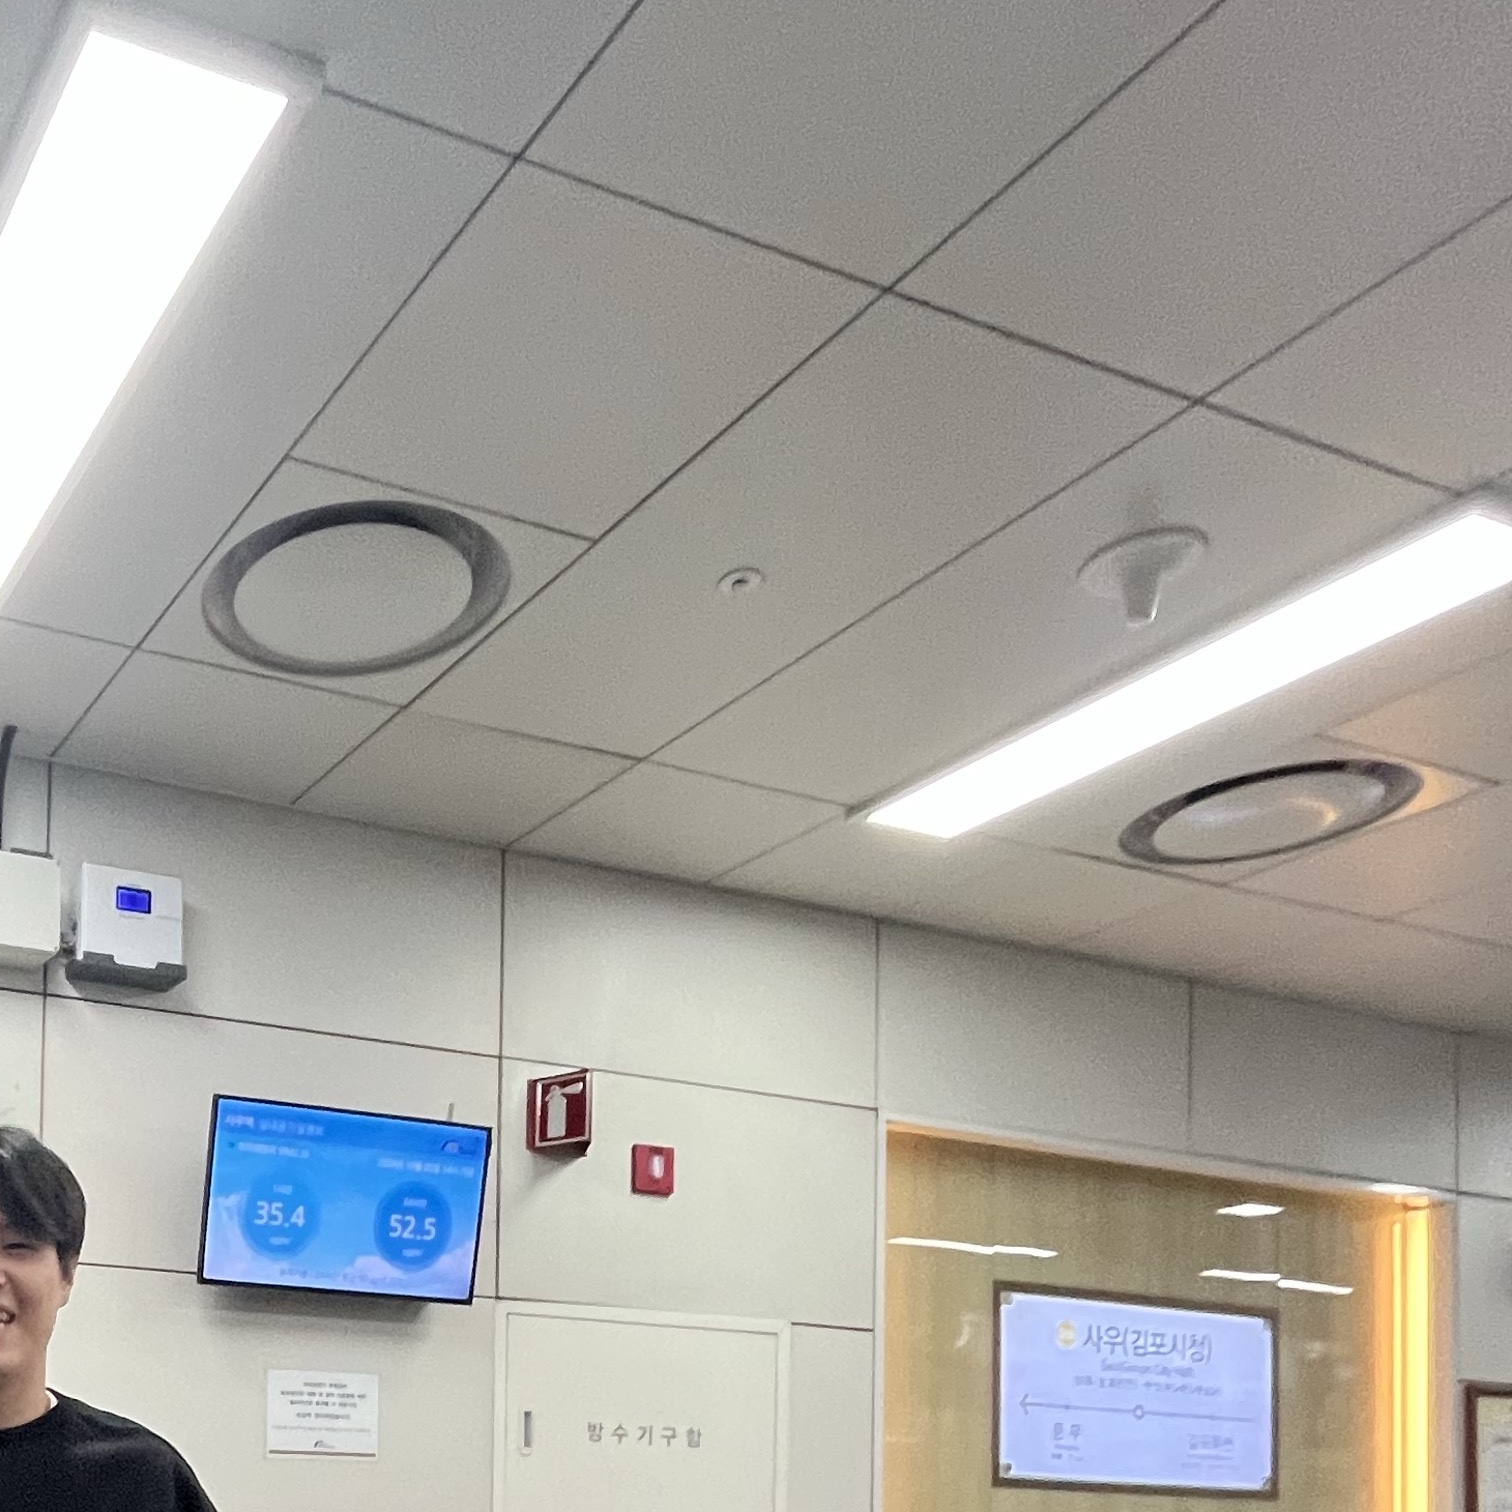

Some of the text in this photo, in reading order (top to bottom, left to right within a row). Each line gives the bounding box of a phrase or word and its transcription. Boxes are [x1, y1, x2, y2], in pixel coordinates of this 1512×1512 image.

[254, 1200, 306, 1229] 35.4
[389, 1213, 437, 1241] 52.5
[1082, 1324, 1213, 1366] 사우(김포시청)
